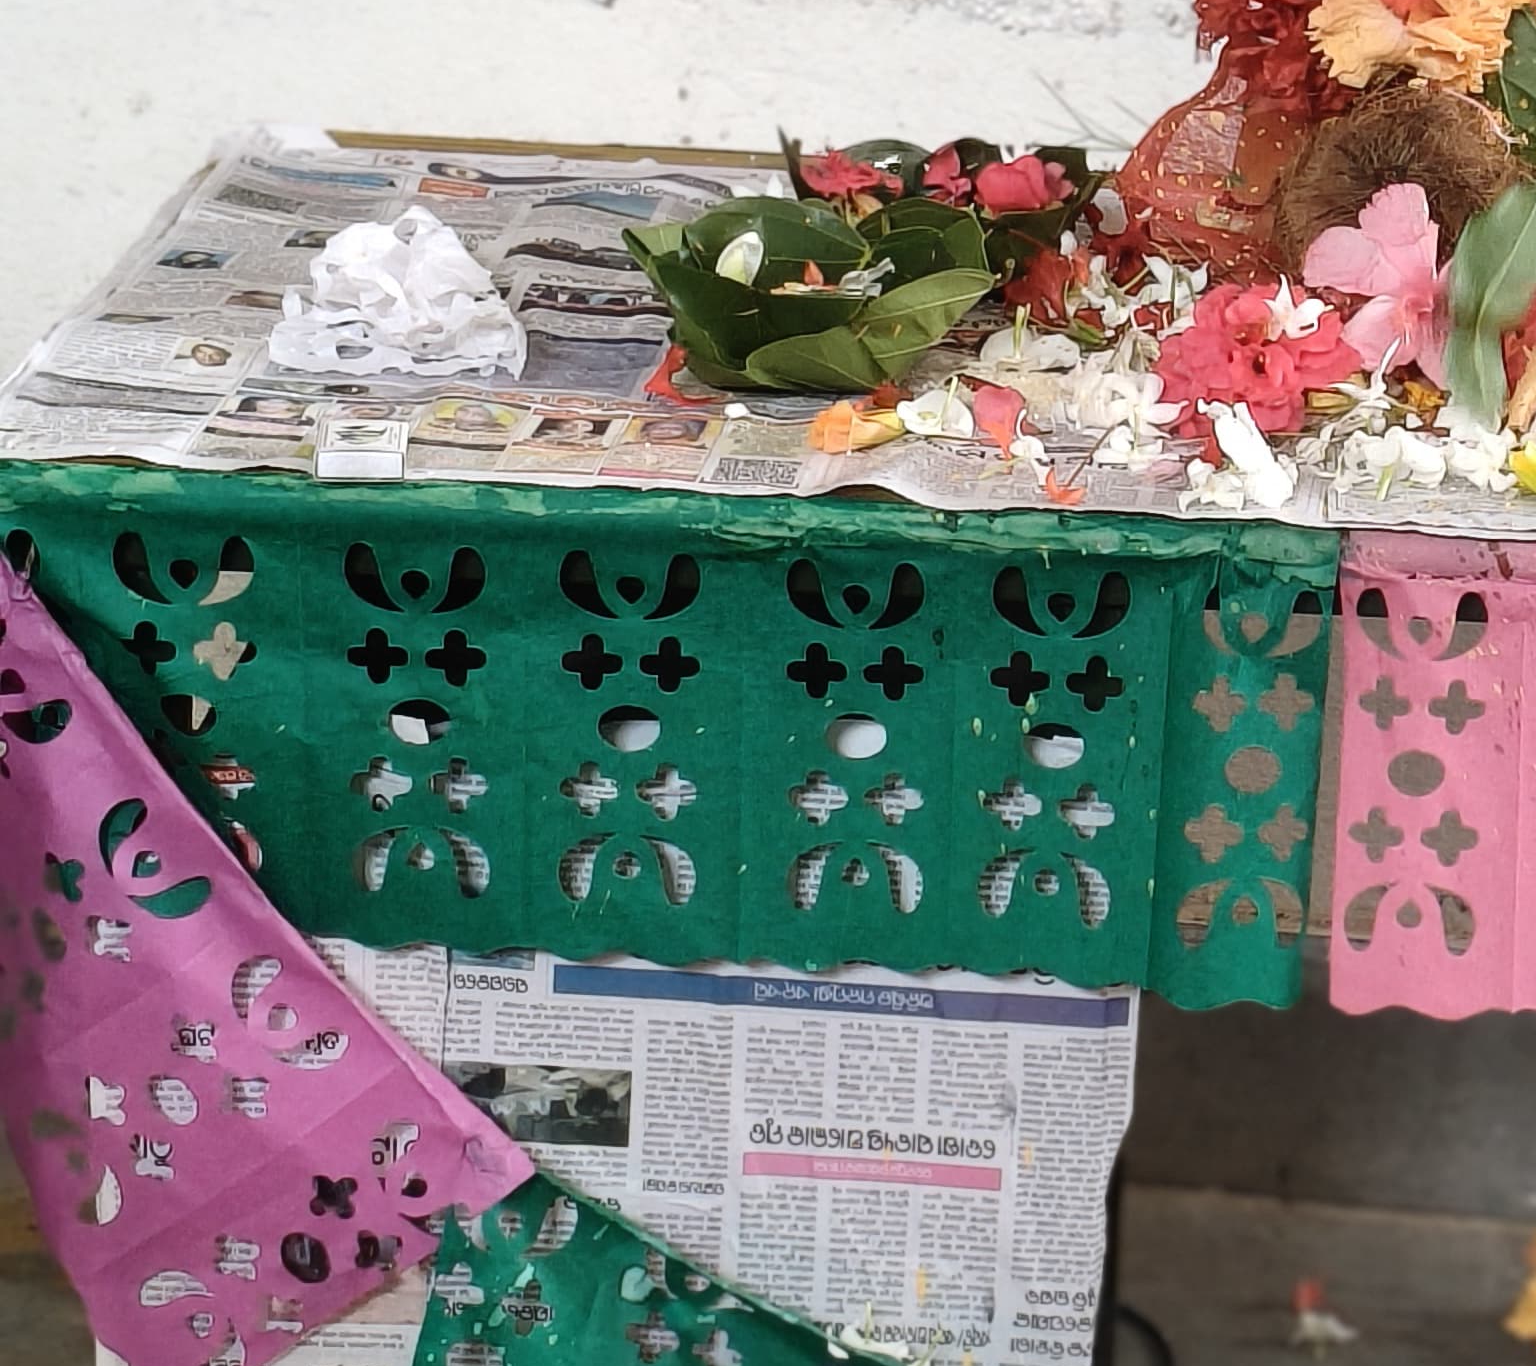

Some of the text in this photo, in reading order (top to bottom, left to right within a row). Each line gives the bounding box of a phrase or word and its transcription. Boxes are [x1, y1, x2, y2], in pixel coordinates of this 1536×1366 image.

[787, 1125, 863, 1150] ଆଲୋକ
[937, 1136, 995, 1159] ଦୋଷୀ
[1013, 1313, 1091, 1333] ଜପେୟୀଙ୍କ
[1010, 1338, 1064, 1359] ବିହାରୀ
